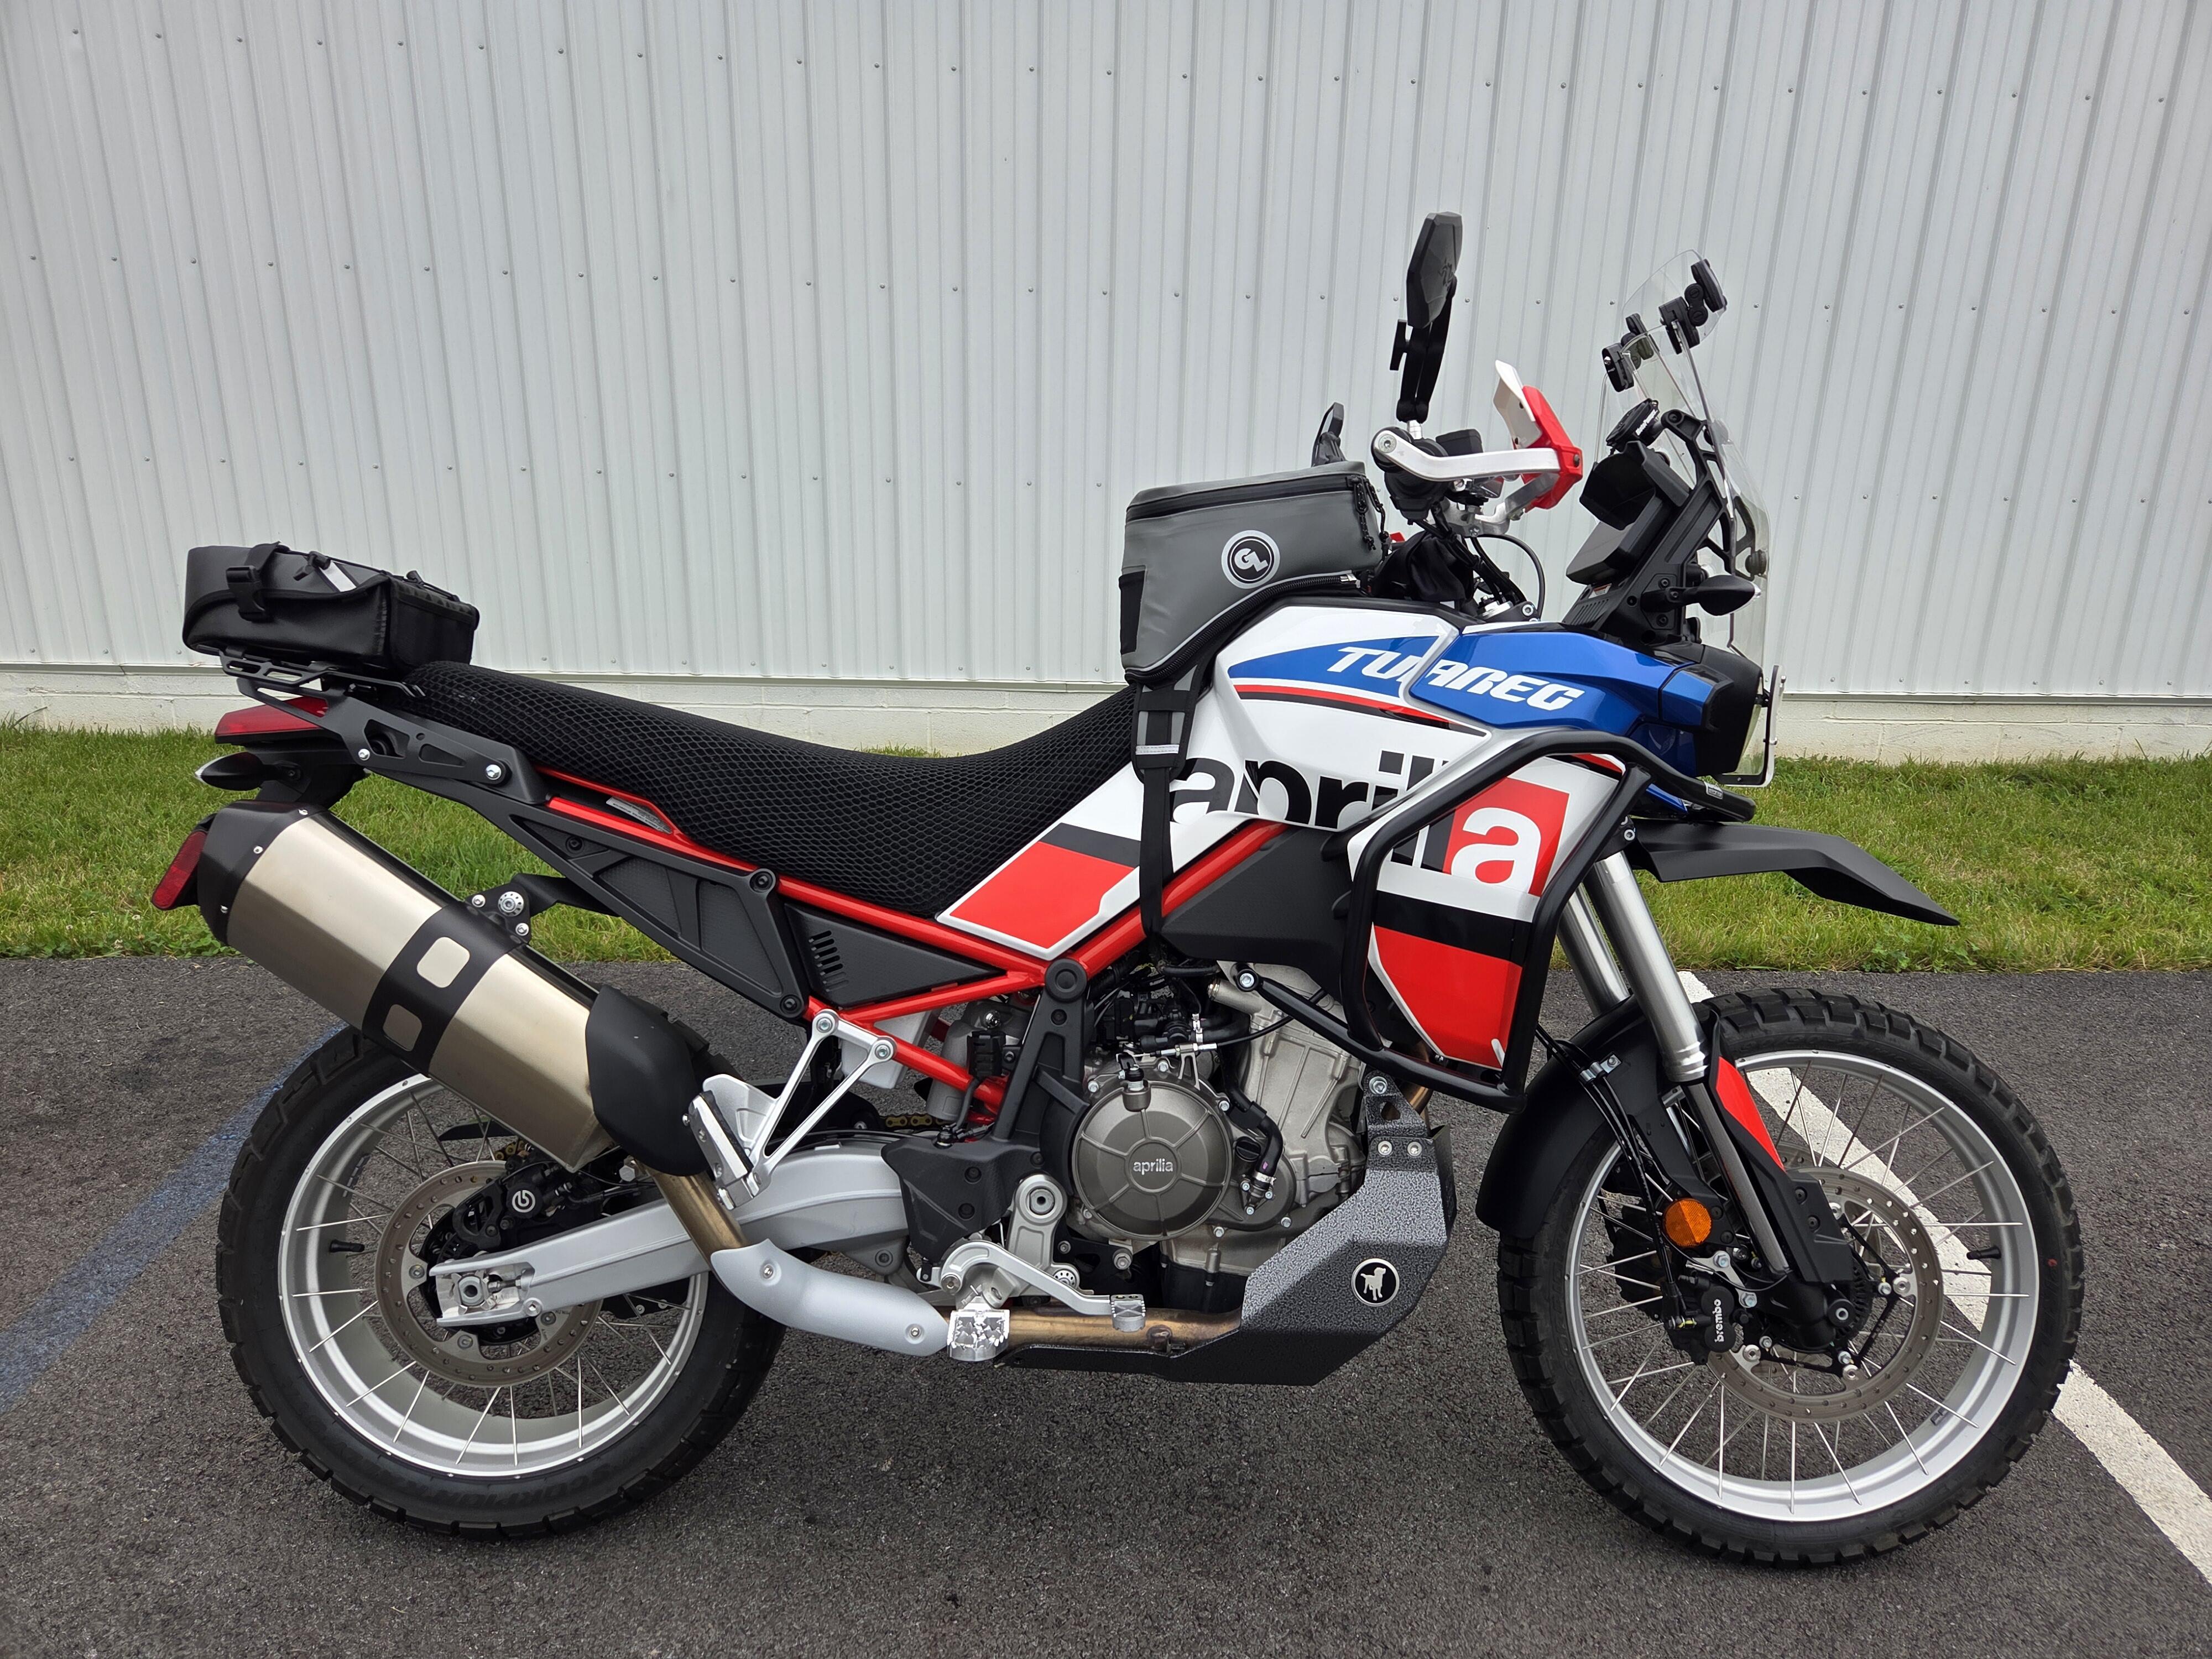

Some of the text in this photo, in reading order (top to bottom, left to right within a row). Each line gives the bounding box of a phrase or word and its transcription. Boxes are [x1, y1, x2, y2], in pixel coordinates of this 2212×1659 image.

[1234, 548, 1269, 572] GL
[1328, 646, 1585, 711] TUAREG
[1133, 1158, 1173, 1175] aprilia
[1712, 1299, 1724, 1343] brembo
